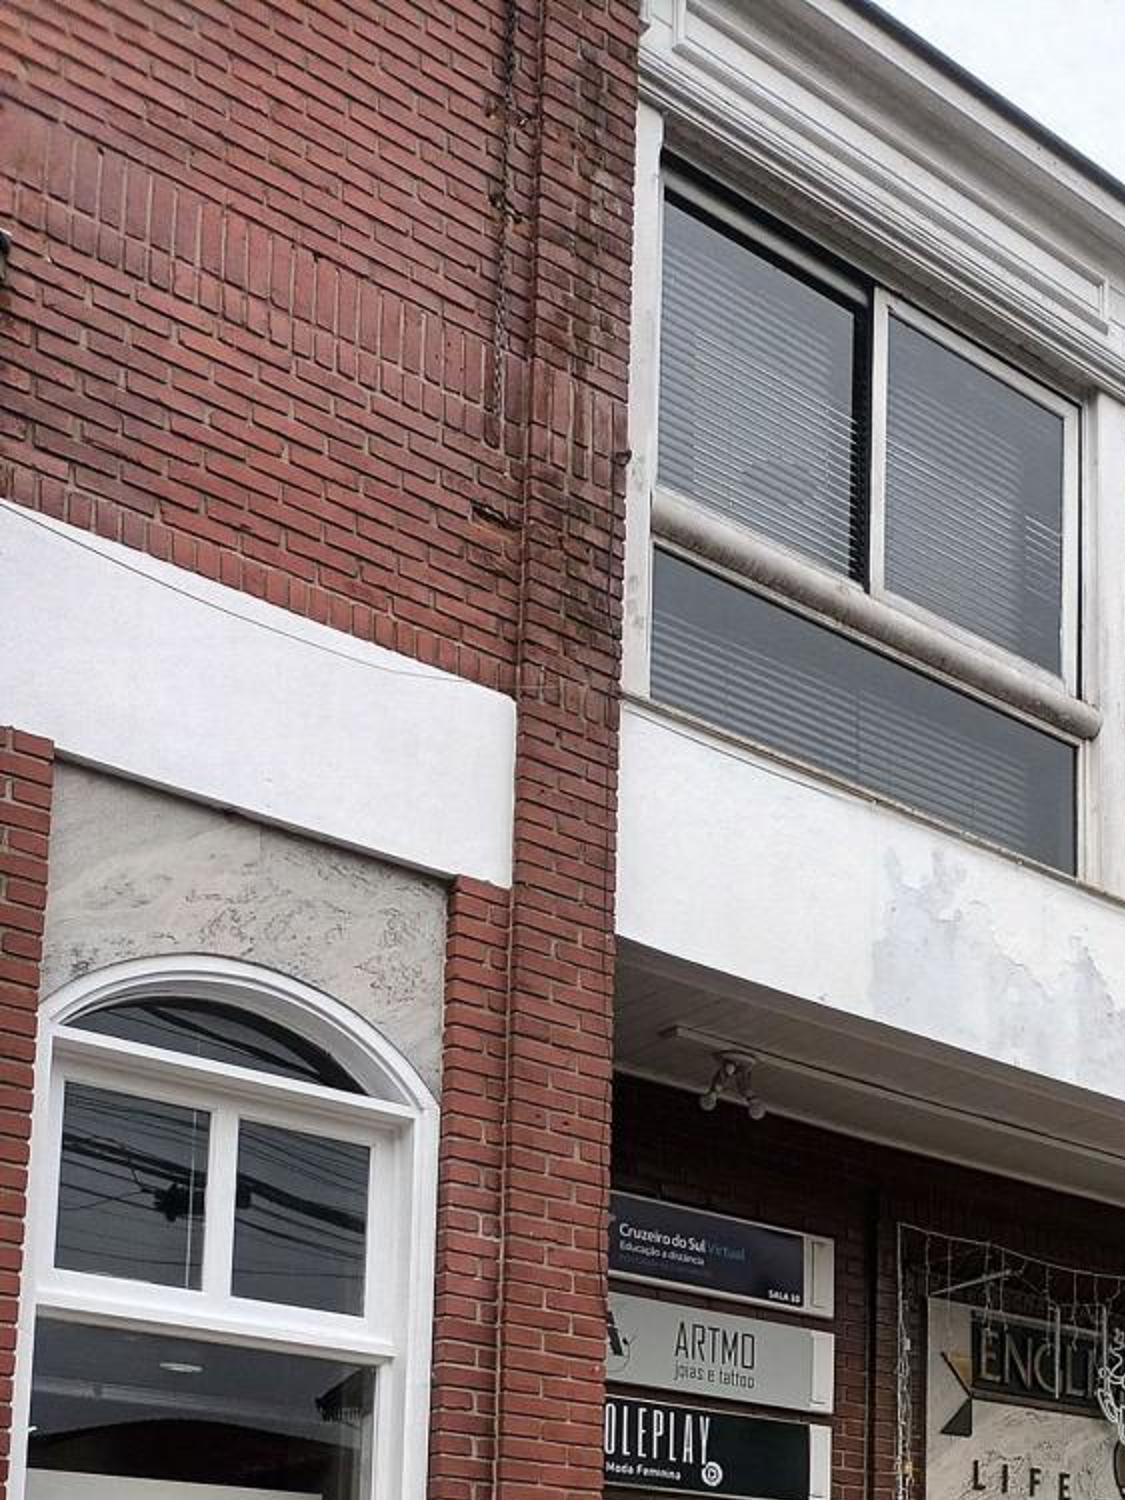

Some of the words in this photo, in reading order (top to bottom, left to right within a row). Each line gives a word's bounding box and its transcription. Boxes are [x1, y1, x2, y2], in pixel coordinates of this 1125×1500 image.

[619, 1223, 671, 1245] Cruzeiro
[671, 1232, 687, 1249] do
[688, 1236, 706, 1254] Sul
[674, 1321, 756, 1371] ARTMO
[707, 1367, 715, 1383] e
[719, 1367, 755, 1389] tattoo
[604, 1403, 711, 1466] OLEPLAY
[605, 1461, 634, 1475] Moda
[636, 1463, 682, 1481] Feminina
